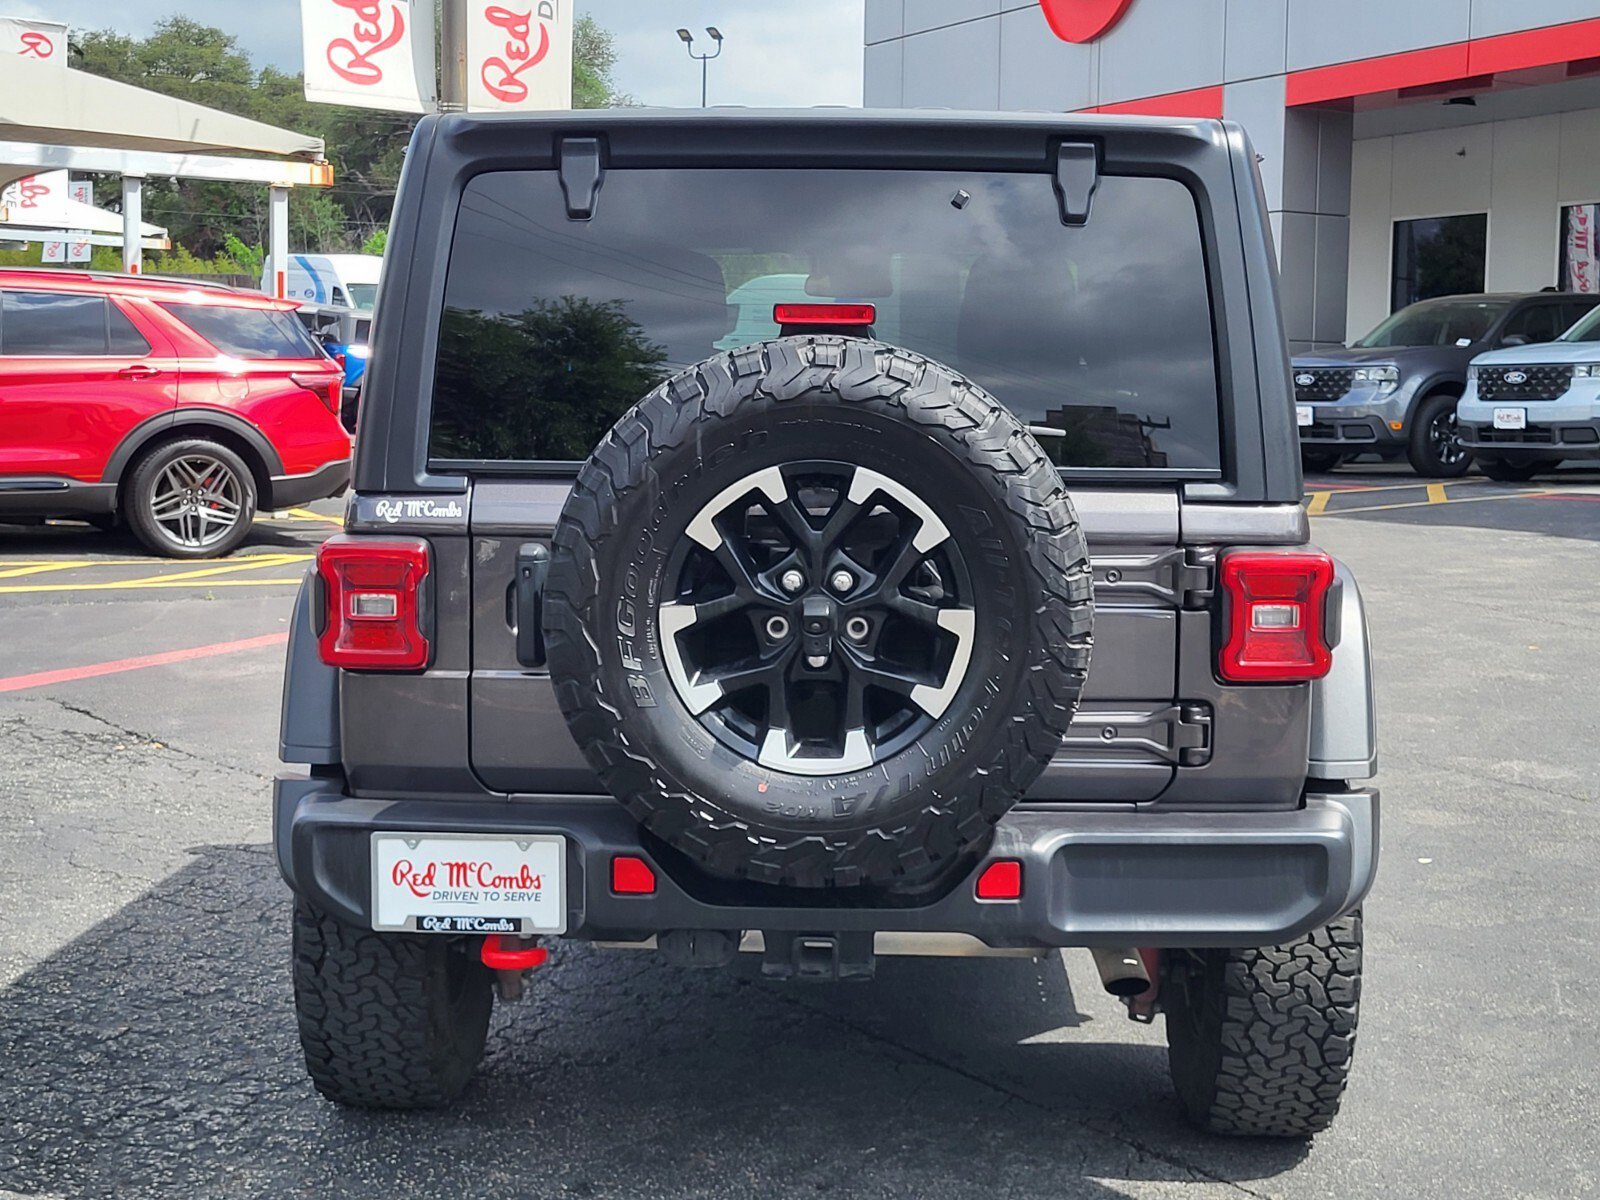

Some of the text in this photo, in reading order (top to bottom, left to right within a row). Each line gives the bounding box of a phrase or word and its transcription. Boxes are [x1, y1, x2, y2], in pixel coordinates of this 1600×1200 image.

[327, 0, 405, 85] Red
[481, 5, 549, 103] Red
[375, 499, 463, 523] Red McCombs
[392, 859, 542, 898] Red McCombs
[432, 891, 542, 902] DRIVEN TO SERVE
[422, 915, 515, 932] Red McCombs
